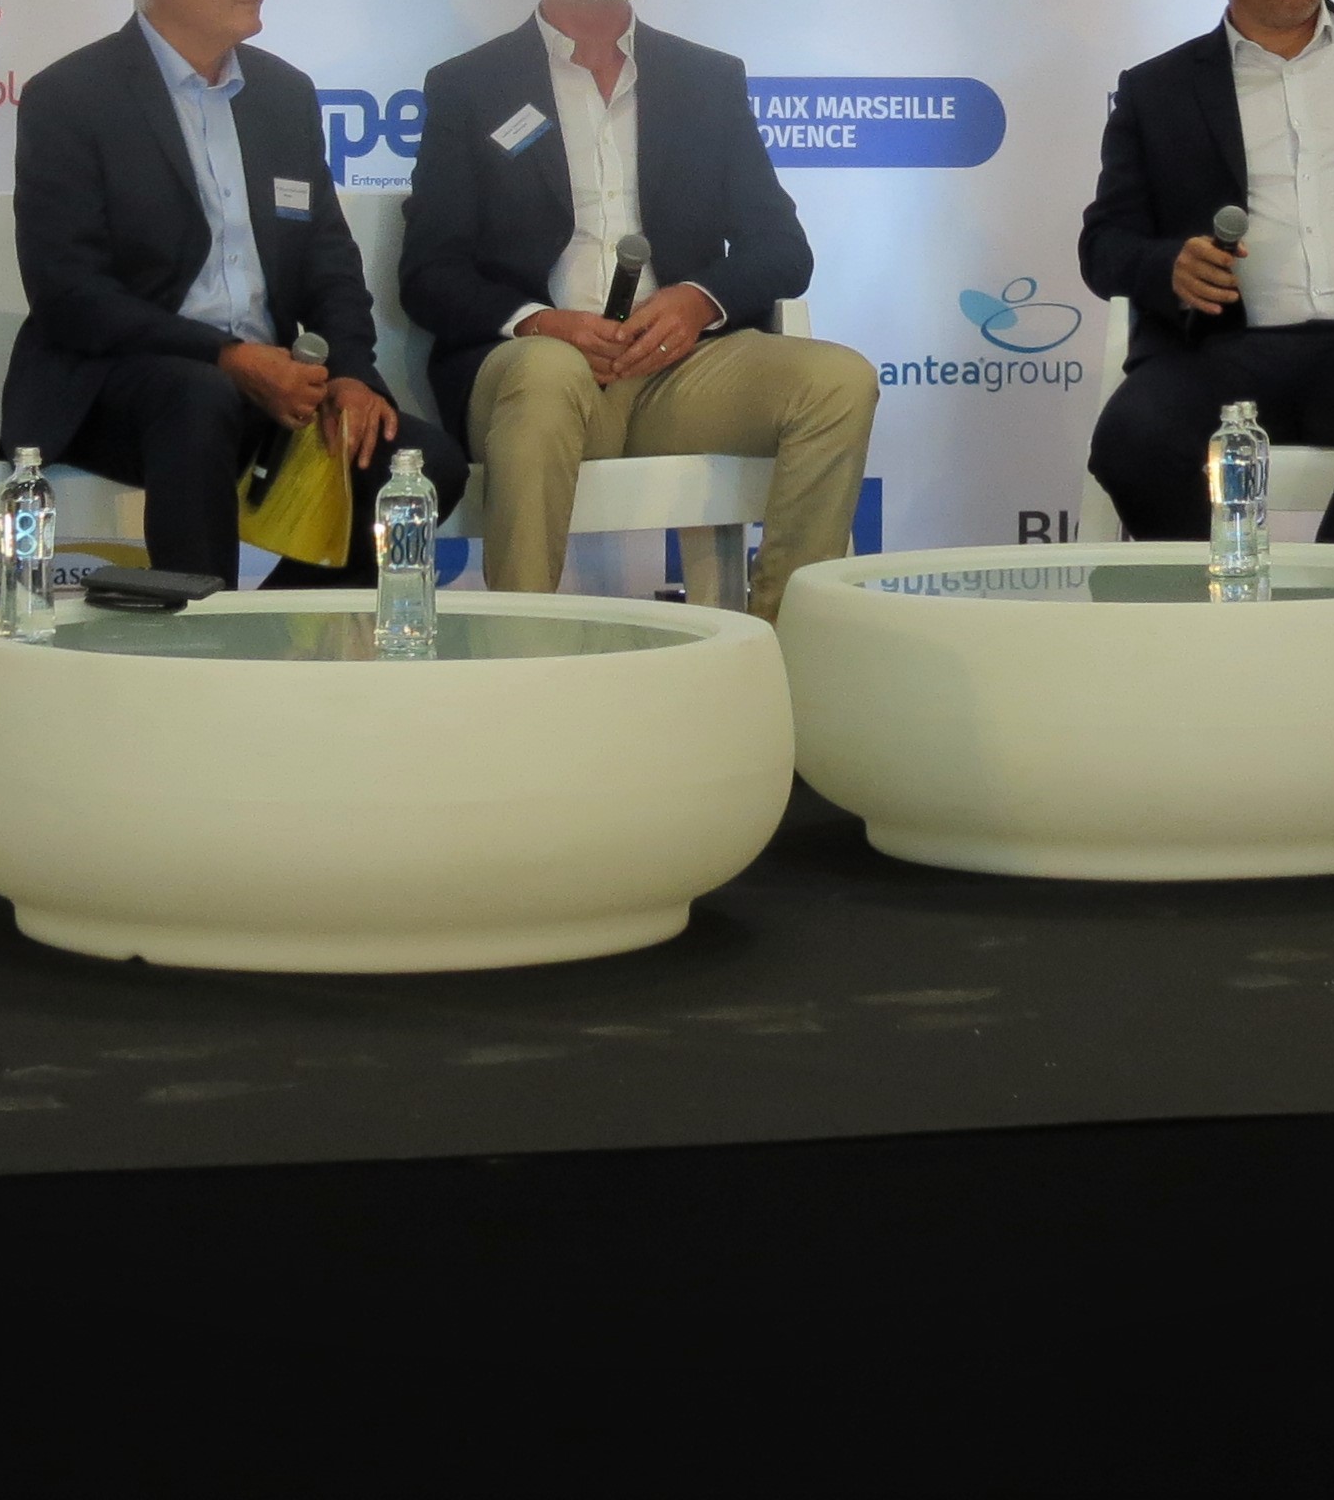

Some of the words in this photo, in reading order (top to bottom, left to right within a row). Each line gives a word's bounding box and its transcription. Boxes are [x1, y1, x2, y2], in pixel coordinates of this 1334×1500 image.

[768, 96, 809, 119] AIX
[817, 96, 955, 119] MARSEILLE
[315, 89, 427, 187] pe
[759, 124, 856, 148] OVENCE
[352, 175, 411, 188] Entrepren
